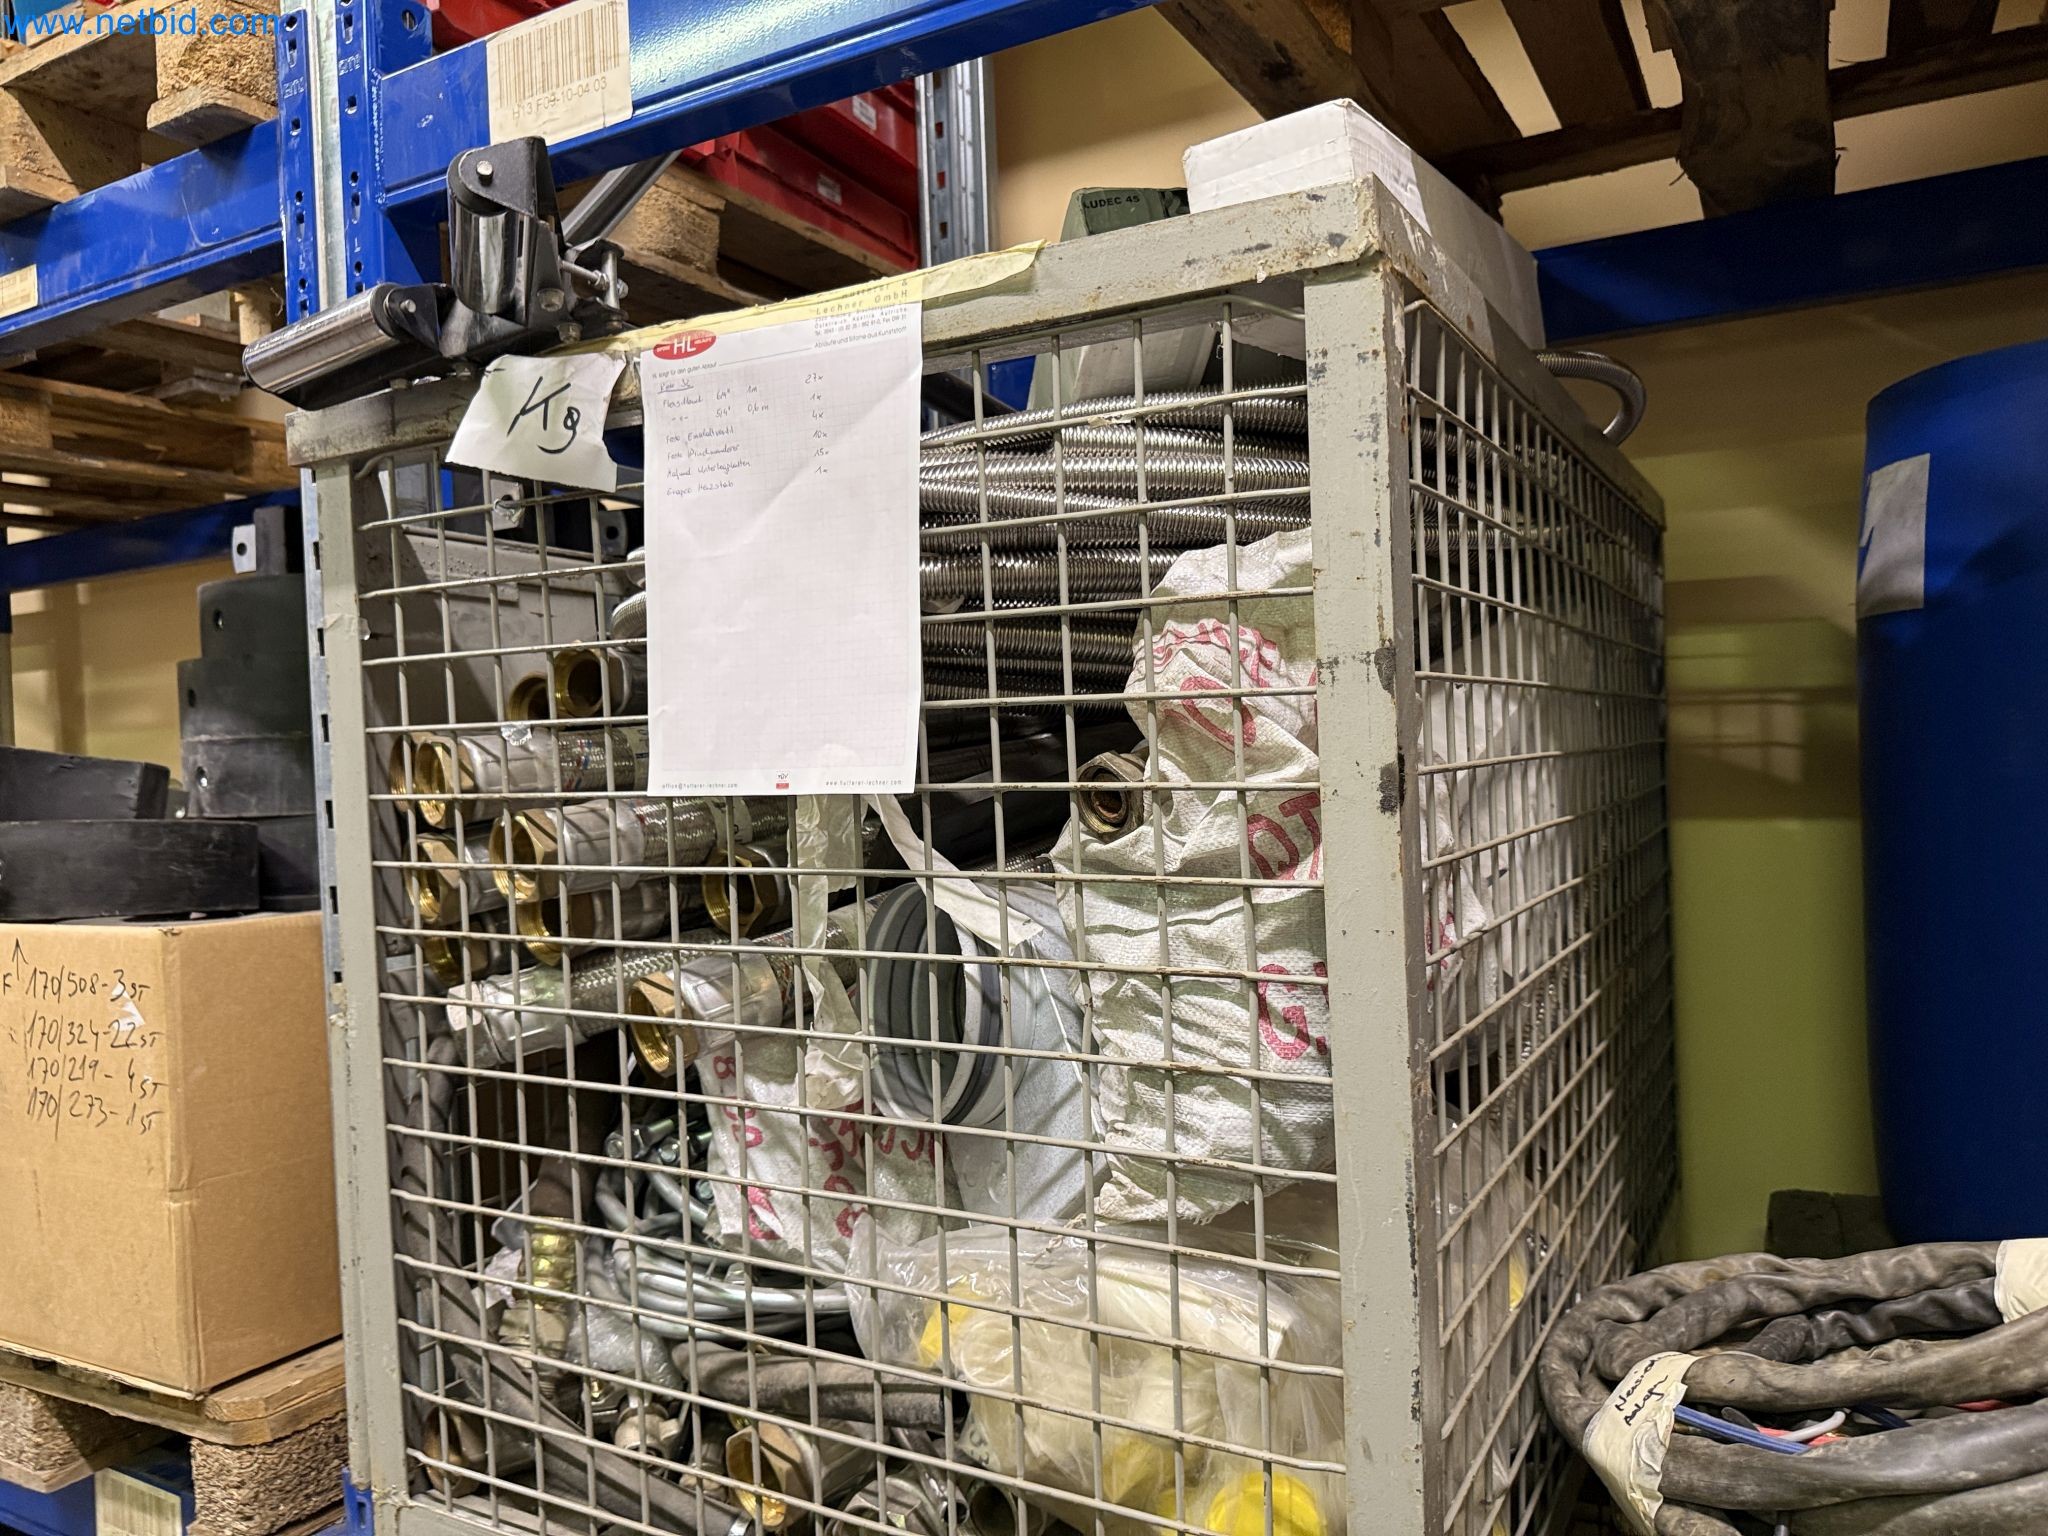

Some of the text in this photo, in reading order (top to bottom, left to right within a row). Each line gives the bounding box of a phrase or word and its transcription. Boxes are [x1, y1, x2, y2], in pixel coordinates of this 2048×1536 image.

[816, 300, 863, 315] Lechner
[875, 290, 908, 303] GmbH
[673, 335, 697, 355] HL
[507, 376, 581, 455] Kg
